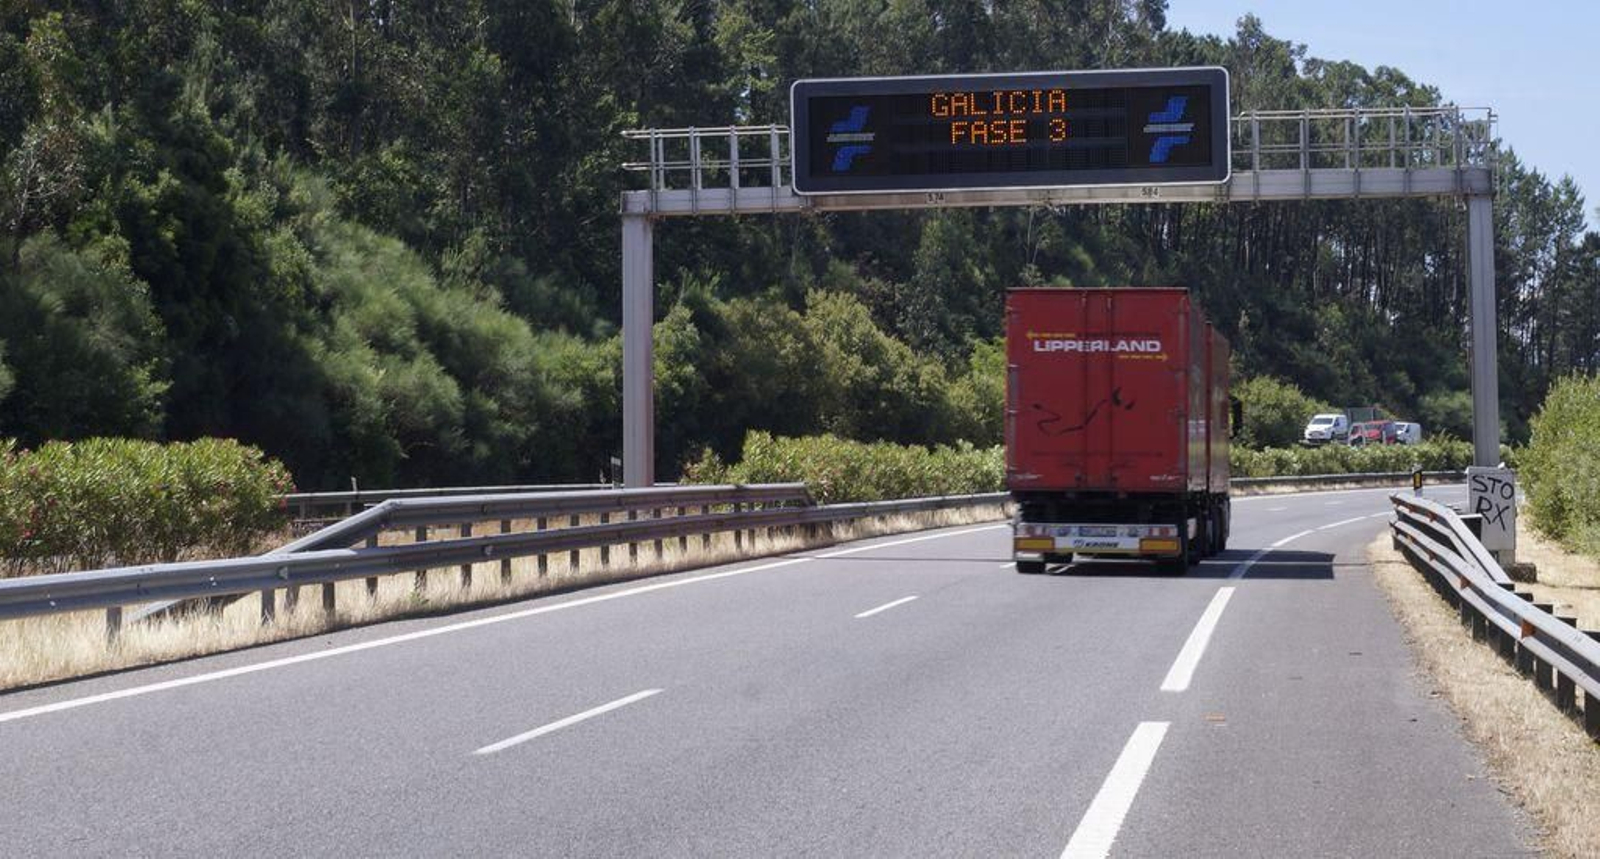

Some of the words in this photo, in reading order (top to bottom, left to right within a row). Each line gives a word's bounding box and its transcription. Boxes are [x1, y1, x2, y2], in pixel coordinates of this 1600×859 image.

[931, 89, 1066, 117] GALICIA
[951, 120, 1027, 144] FASE
[1049, 118, 1066, 142] 3
[1034, 339, 1162, 352] LIPPERLAND
[1472, 474, 1515, 499] STO
[1475, 496, 1510, 531] RX
